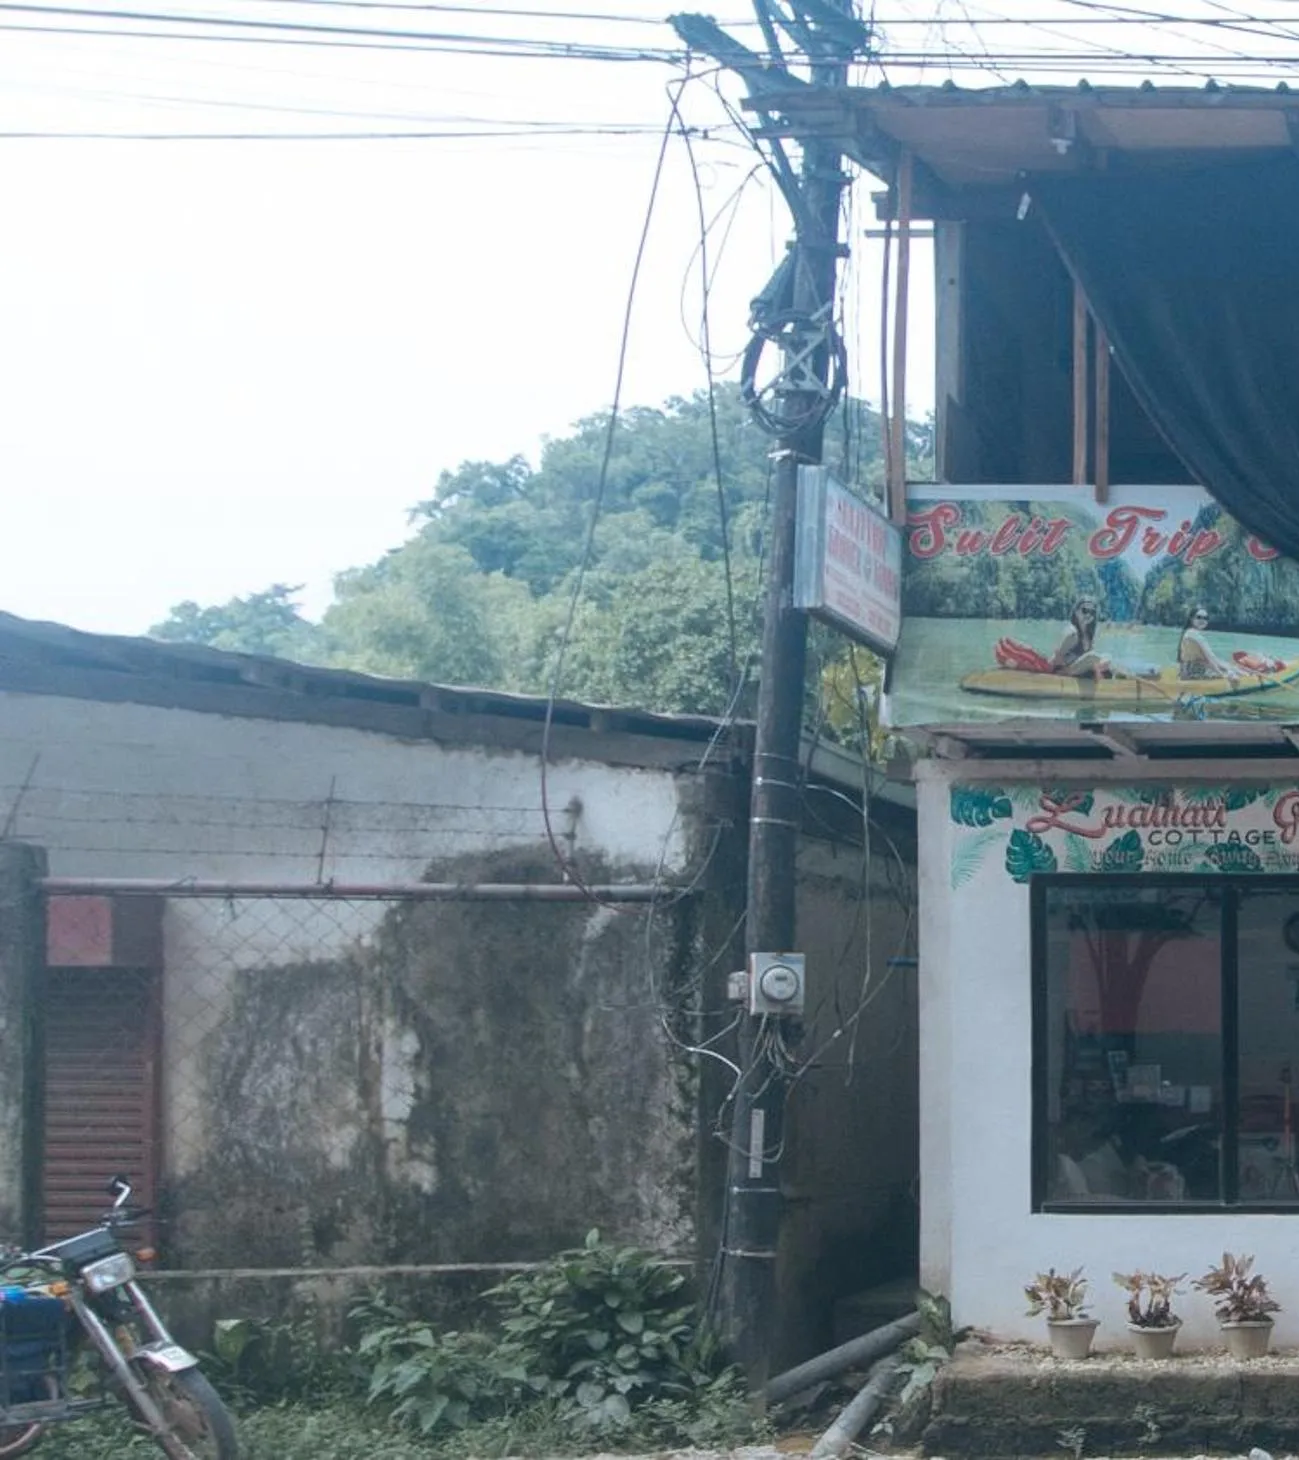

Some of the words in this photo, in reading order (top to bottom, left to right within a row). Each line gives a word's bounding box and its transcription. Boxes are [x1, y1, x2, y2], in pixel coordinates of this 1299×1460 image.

[908, 501, 1074, 560] Sulit
[1090, 504, 1227, 566] Trip
[1148, 829, 1277, 847] COTTAGE
